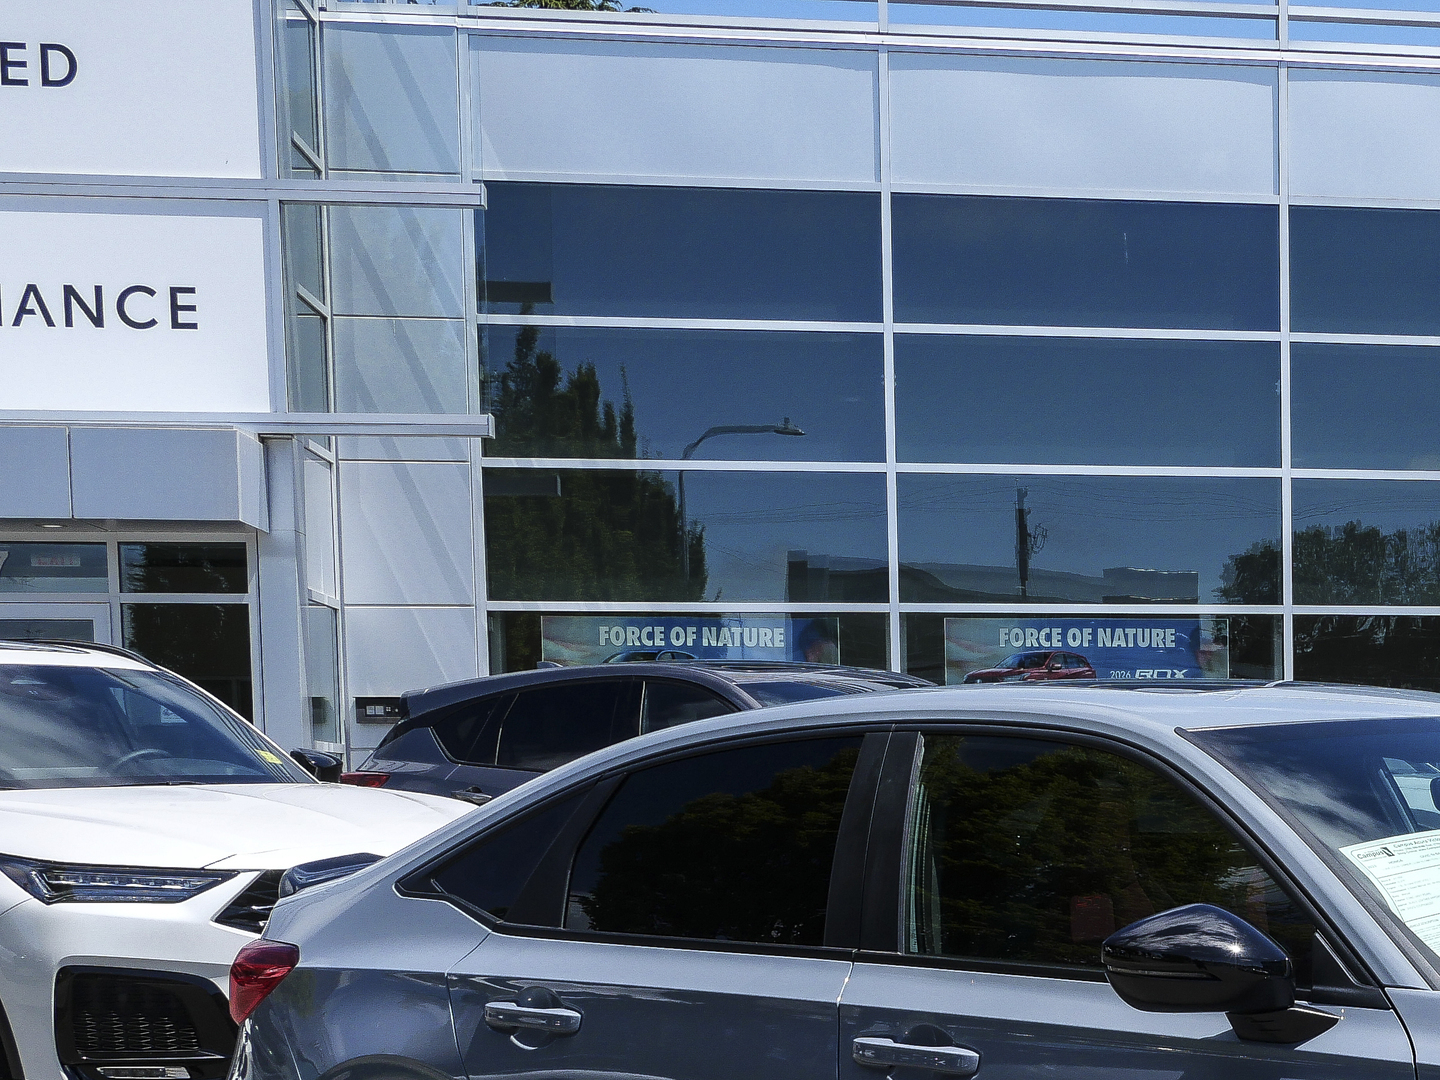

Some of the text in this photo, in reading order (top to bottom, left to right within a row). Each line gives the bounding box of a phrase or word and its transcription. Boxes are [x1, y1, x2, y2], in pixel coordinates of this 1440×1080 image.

[0, 42, 78, 87] ED
[0, 284, 198, 330] ANCE
[599, 626, 785, 648] FORCE OF NATURE
[1000, 627, 1176, 648] FORCE OF NATURE
[1109, 670, 1131, 679] 2026
[1356, 849, 1384, 860] Campus
